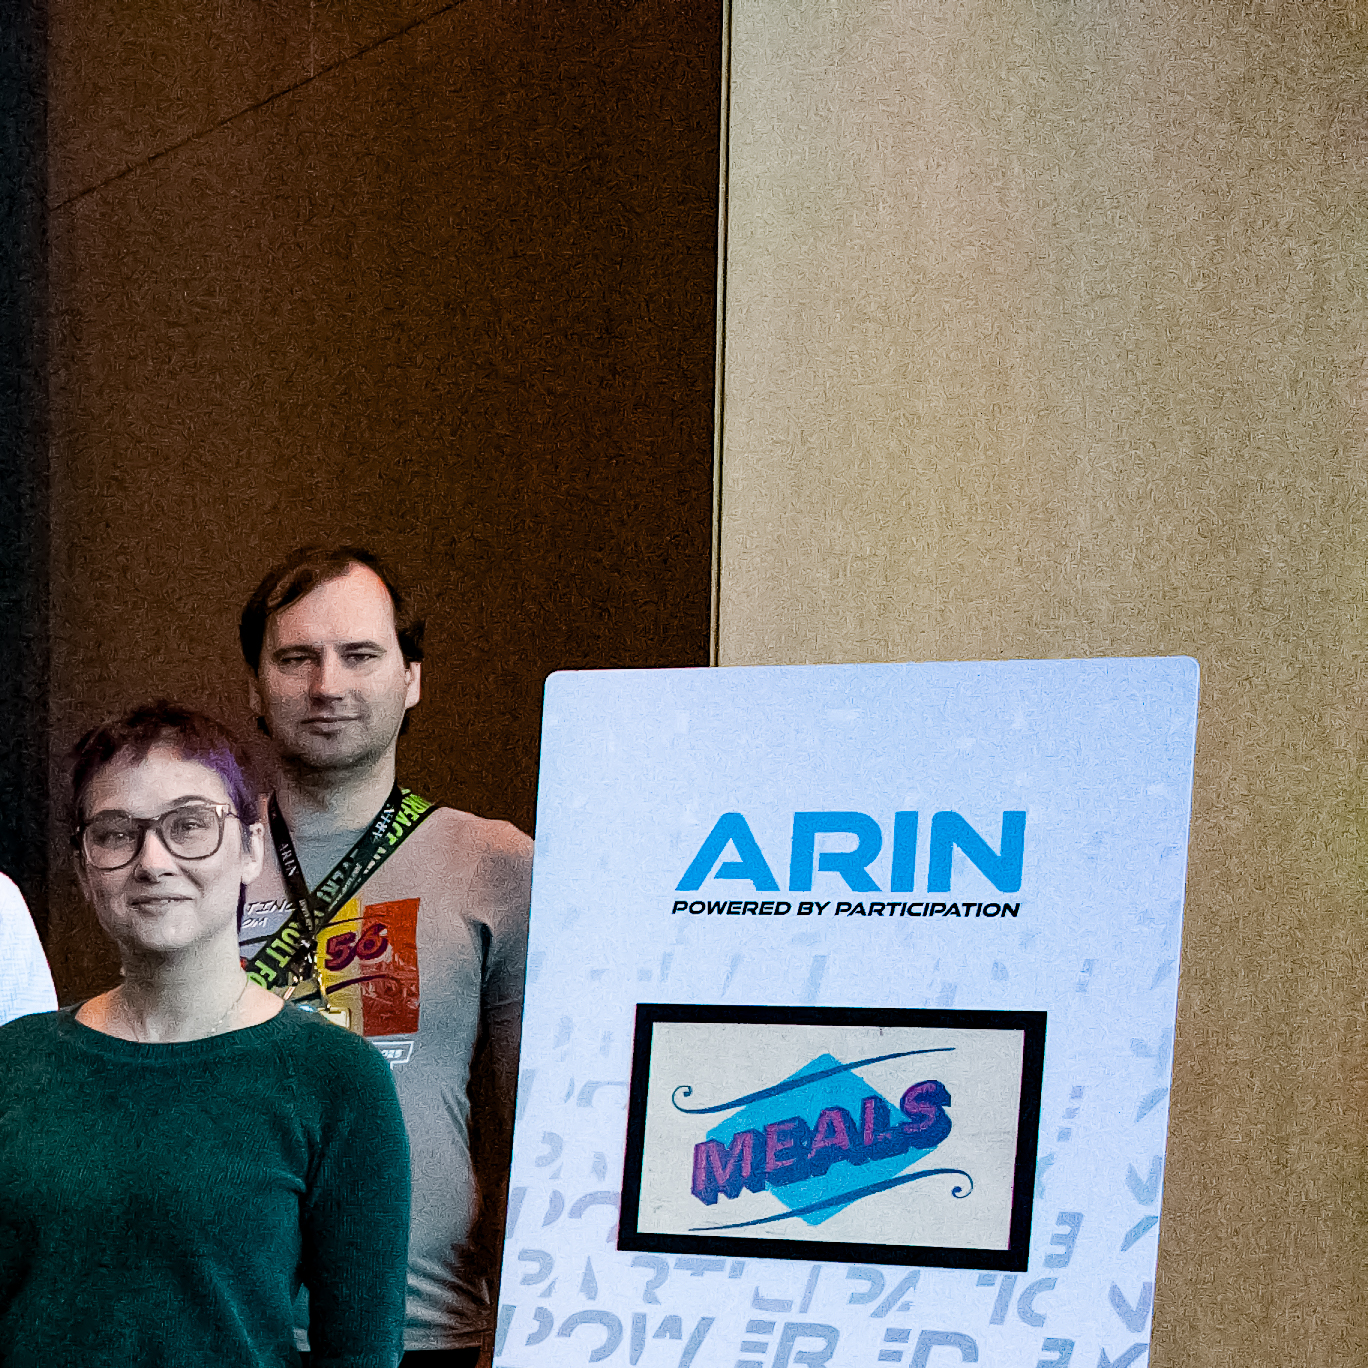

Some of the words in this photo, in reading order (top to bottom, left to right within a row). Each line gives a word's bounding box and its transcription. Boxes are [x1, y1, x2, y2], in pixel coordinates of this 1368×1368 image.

[675, 810, 1027, 894] ARIN
[671, 900, 792, 916] POWERED
[796, 901, 832, 916] BY
[834, 902, 1021, 918] PARTICIPATION
[691, 1079, 952, 1206] MEALS
